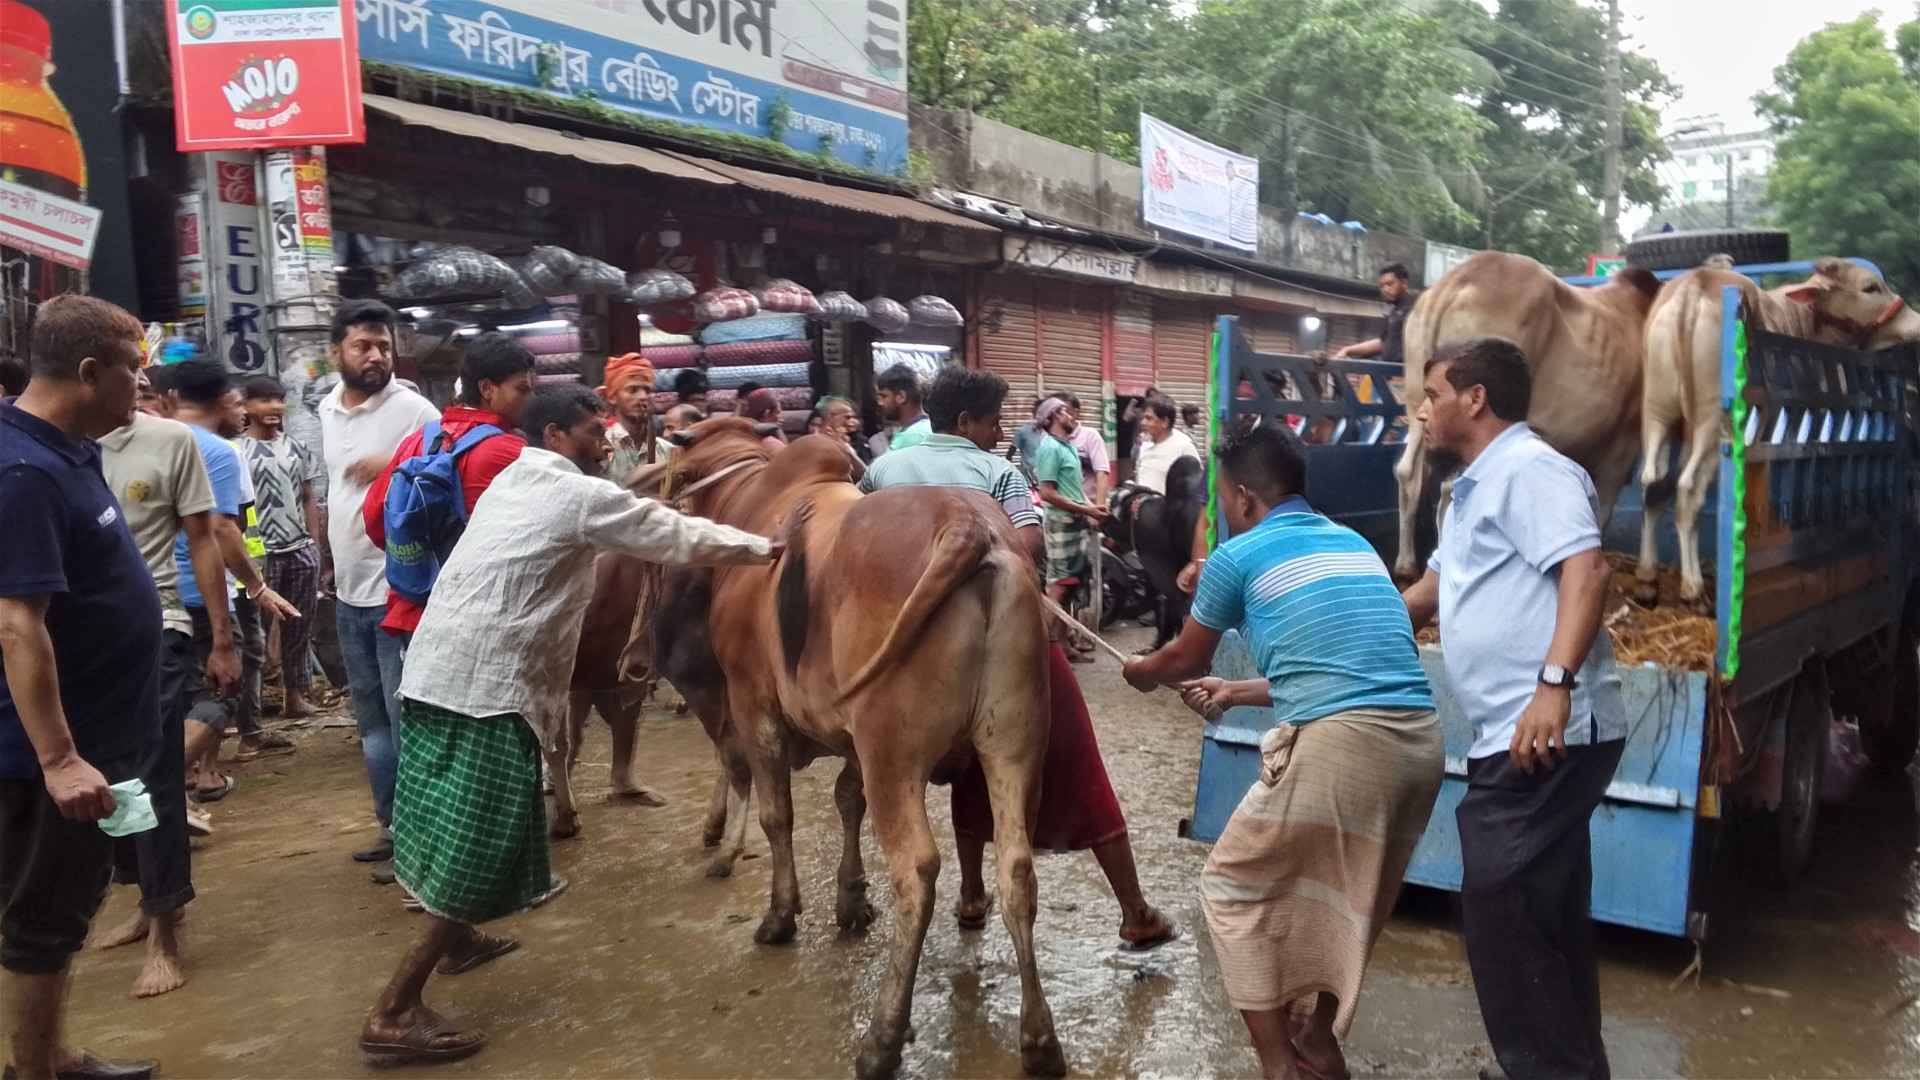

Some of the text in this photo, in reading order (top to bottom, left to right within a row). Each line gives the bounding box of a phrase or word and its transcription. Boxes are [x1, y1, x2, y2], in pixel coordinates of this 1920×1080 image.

[221, 57, 299, 113] MOJO
[602, 53, 682, 113] বেডিং
[692, 71, 761, 128] স্টোর
